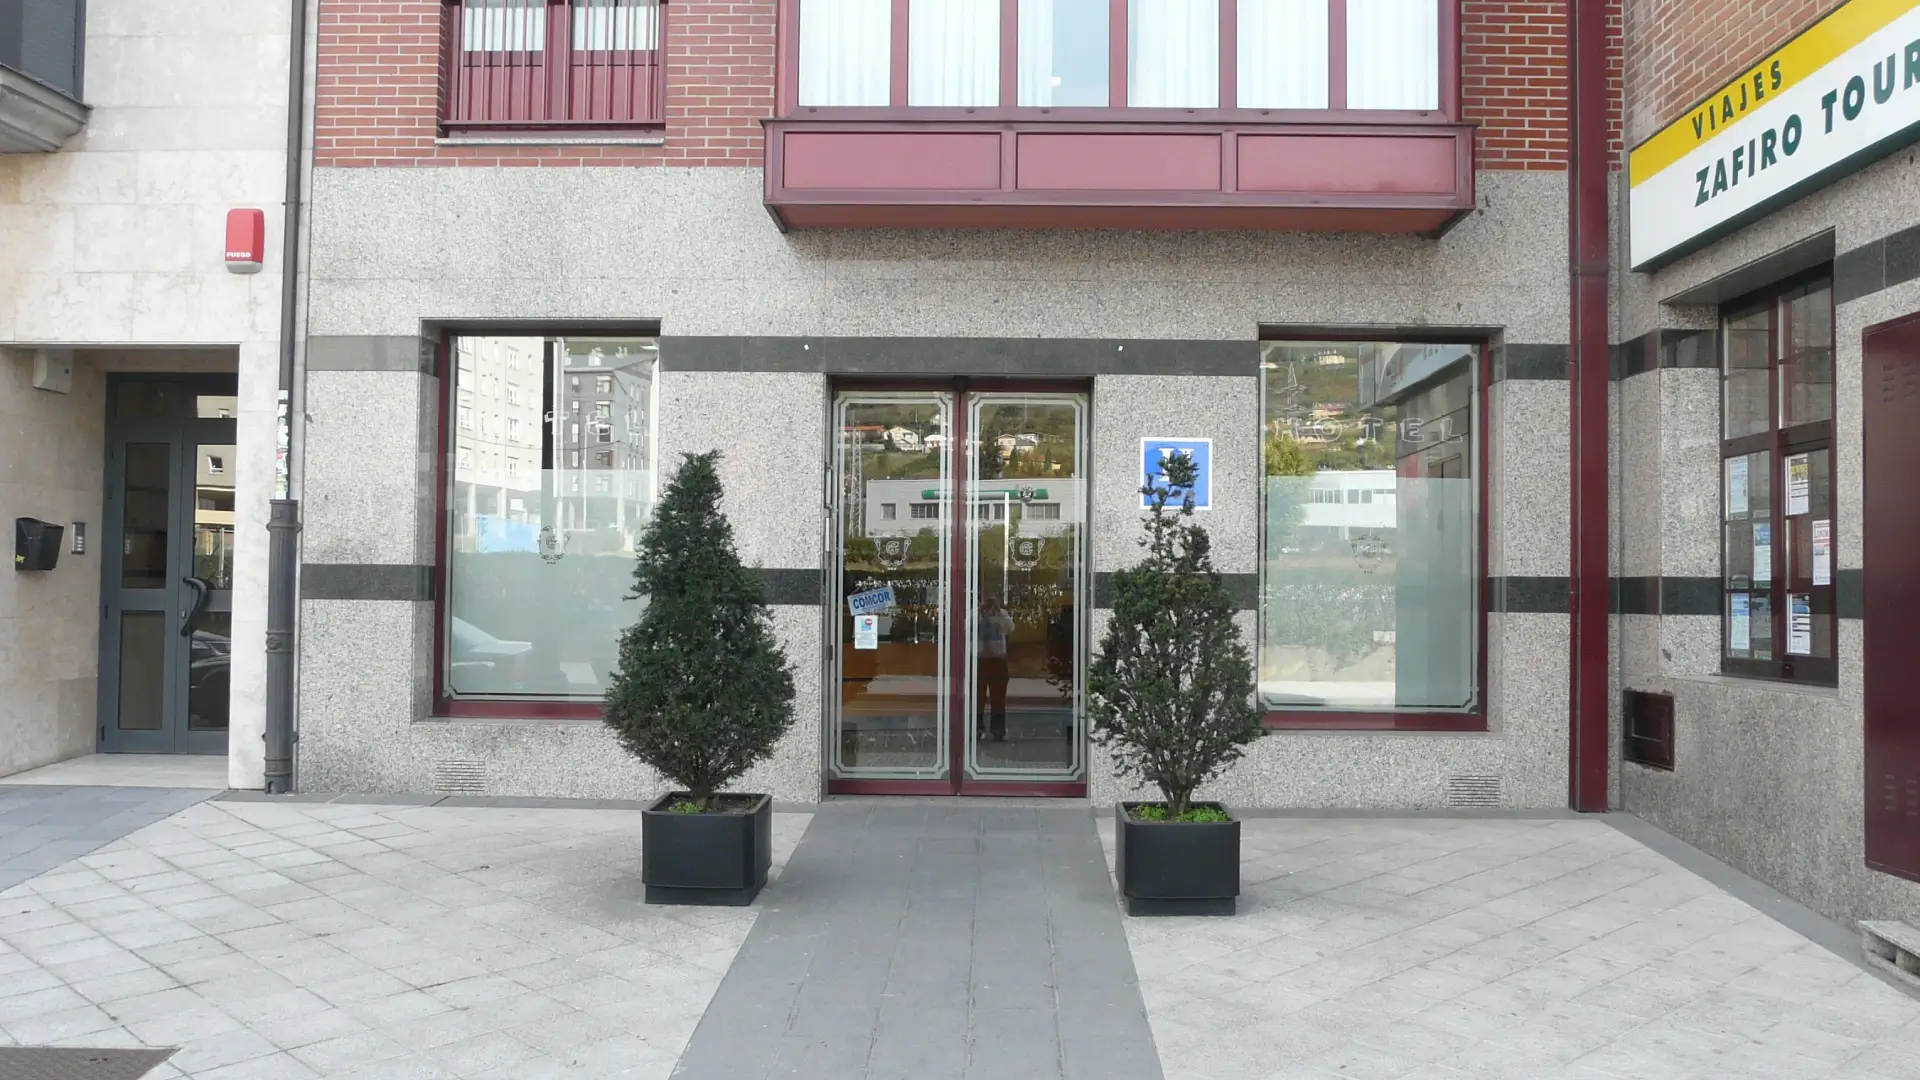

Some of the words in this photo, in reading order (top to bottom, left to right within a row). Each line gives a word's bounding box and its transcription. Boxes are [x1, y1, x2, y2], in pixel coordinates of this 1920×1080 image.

[1692, 60, 1782, 139] VIAJES
[1694, 114, 1802, 207] ZAFIRO
[1274, 417, 1464, 443] HOTEL
